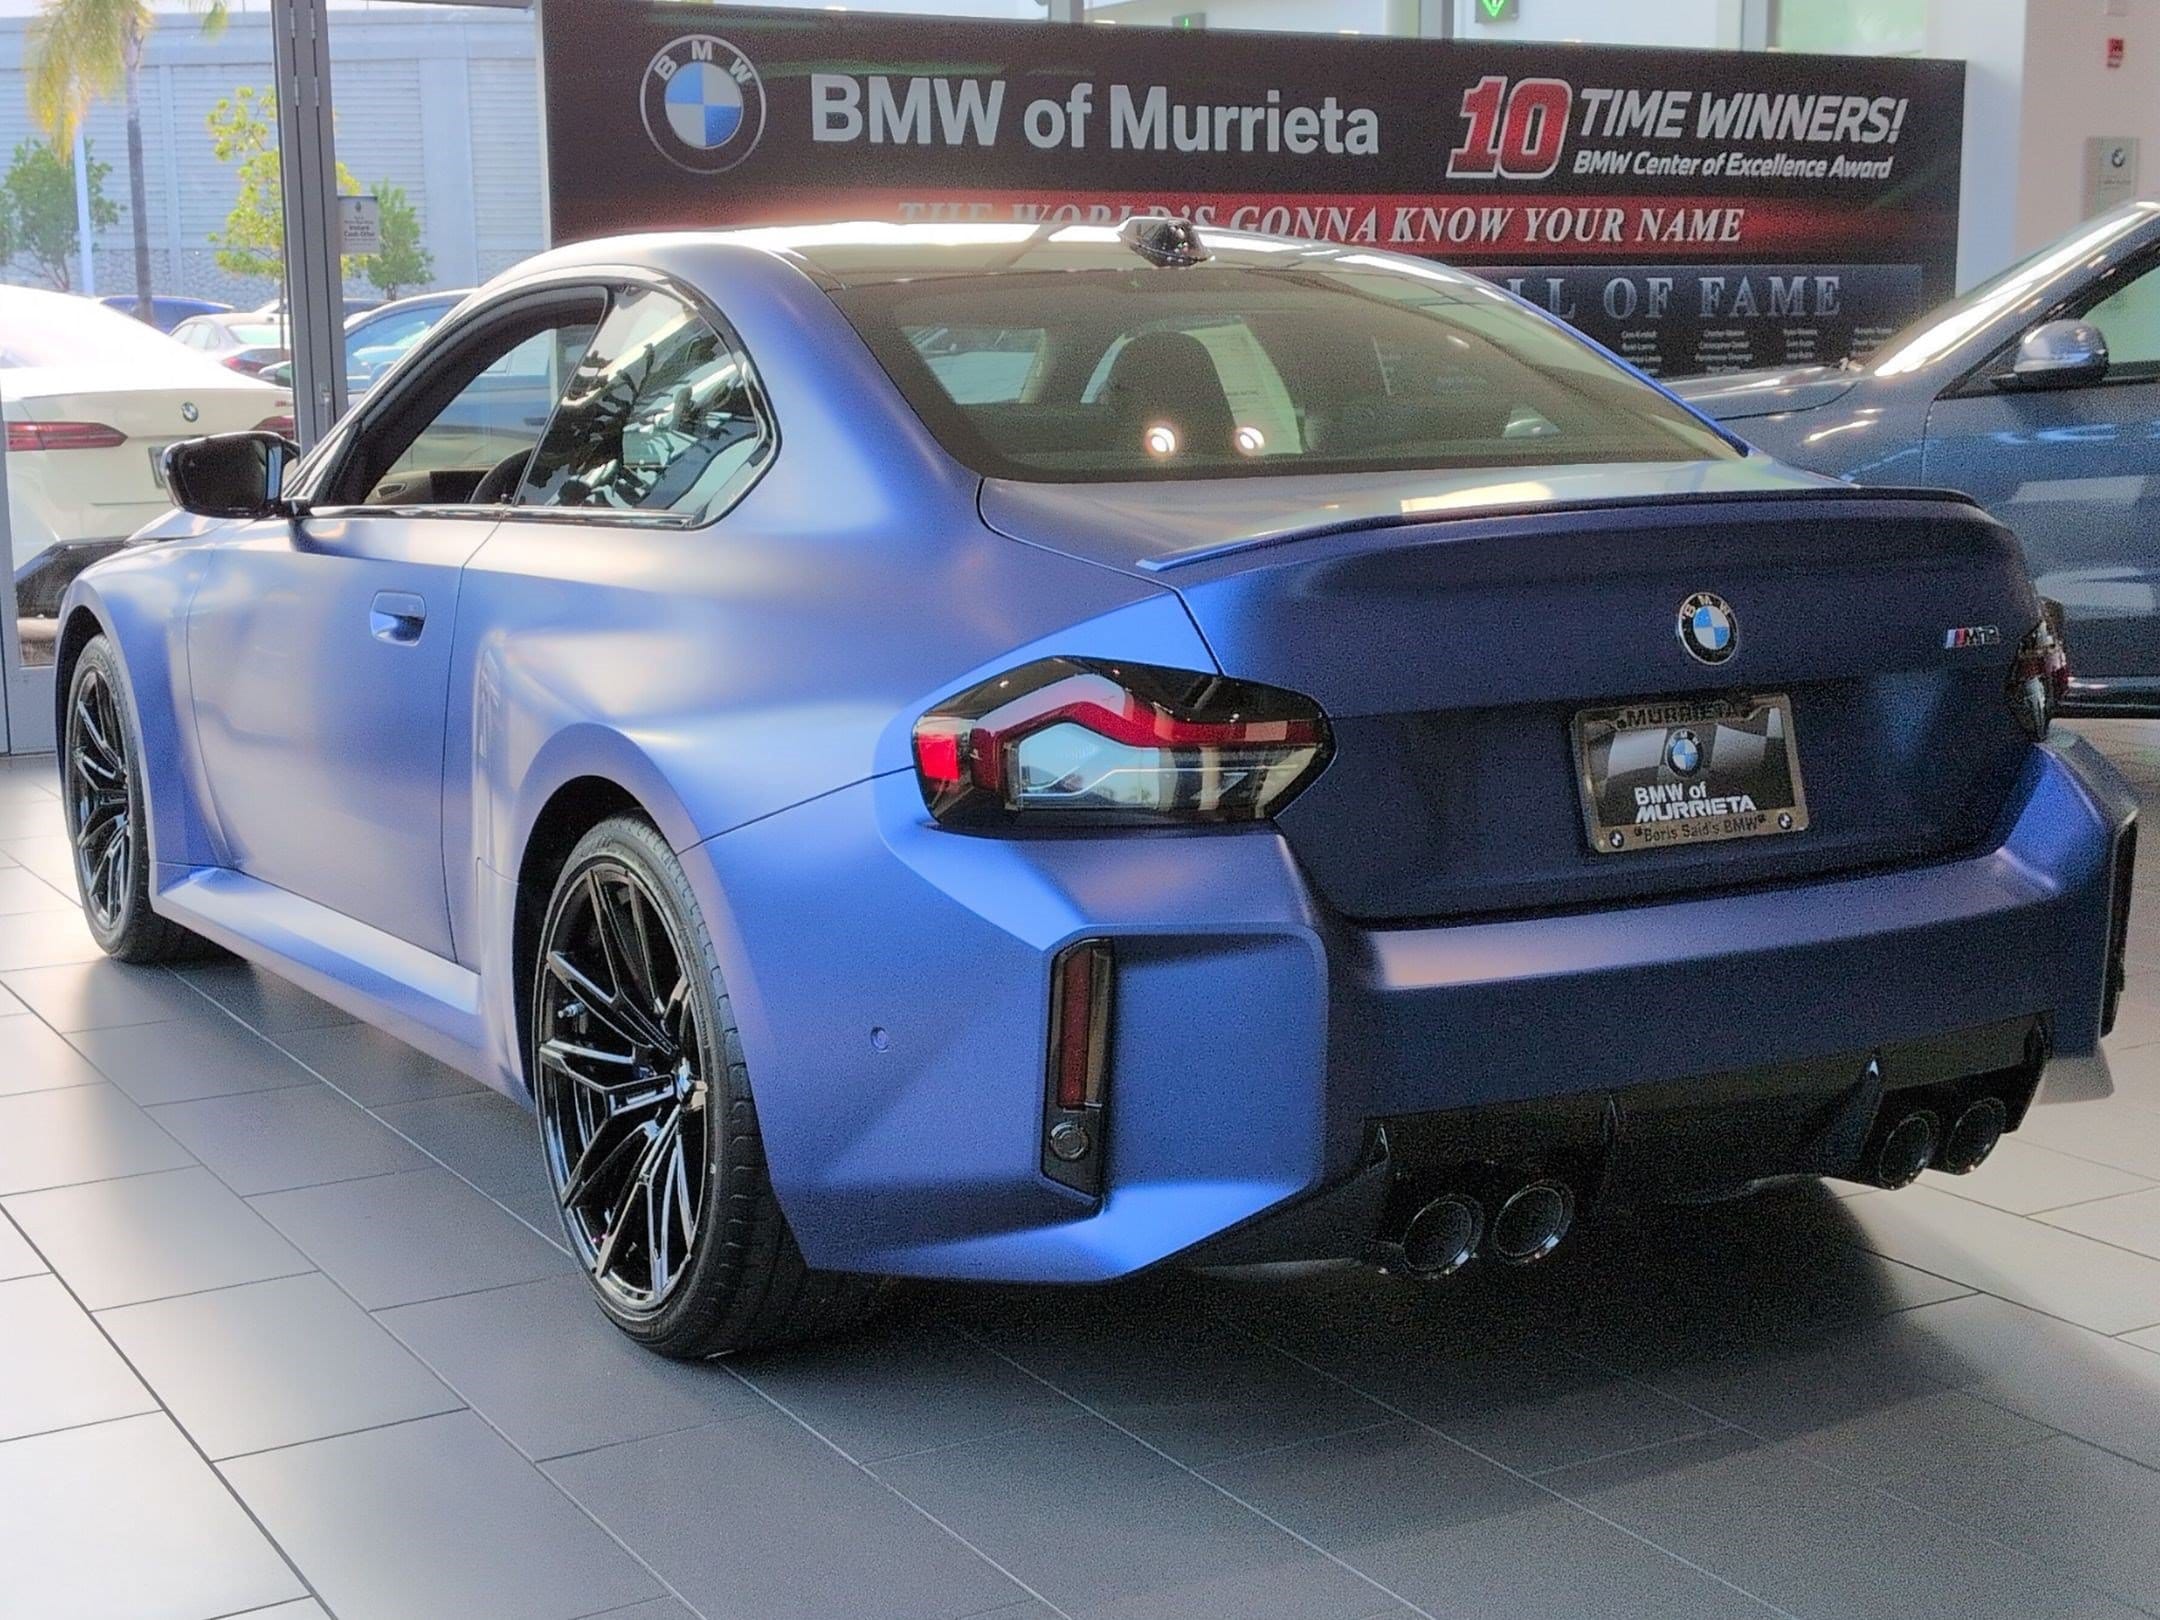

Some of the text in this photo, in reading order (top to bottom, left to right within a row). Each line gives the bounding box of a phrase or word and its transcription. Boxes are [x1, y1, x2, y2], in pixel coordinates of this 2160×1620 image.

[654, 40, 753, 83] BMW
[811, 74, 1379, 155] BMW of Murrieta
[1446, 75, 1909, 180] 10 TIME WINNERS!
[1573, 150, 1894, 180] BMW Center of Excellence Award
[1230, 206, 1378, 242] GONNA
[1388, 206, 1513, 243] KNOW
[1522, 207, 1626, 242] YOUR
[1635, 207, 1745, 243] NAME
[1603, 277, 1675, 320] OF
[1698, 276, 1841, 320] FAME
[1634, 781, 1706, 806] BMW of
[1635, 794, 1757, 824] MURRIETA
